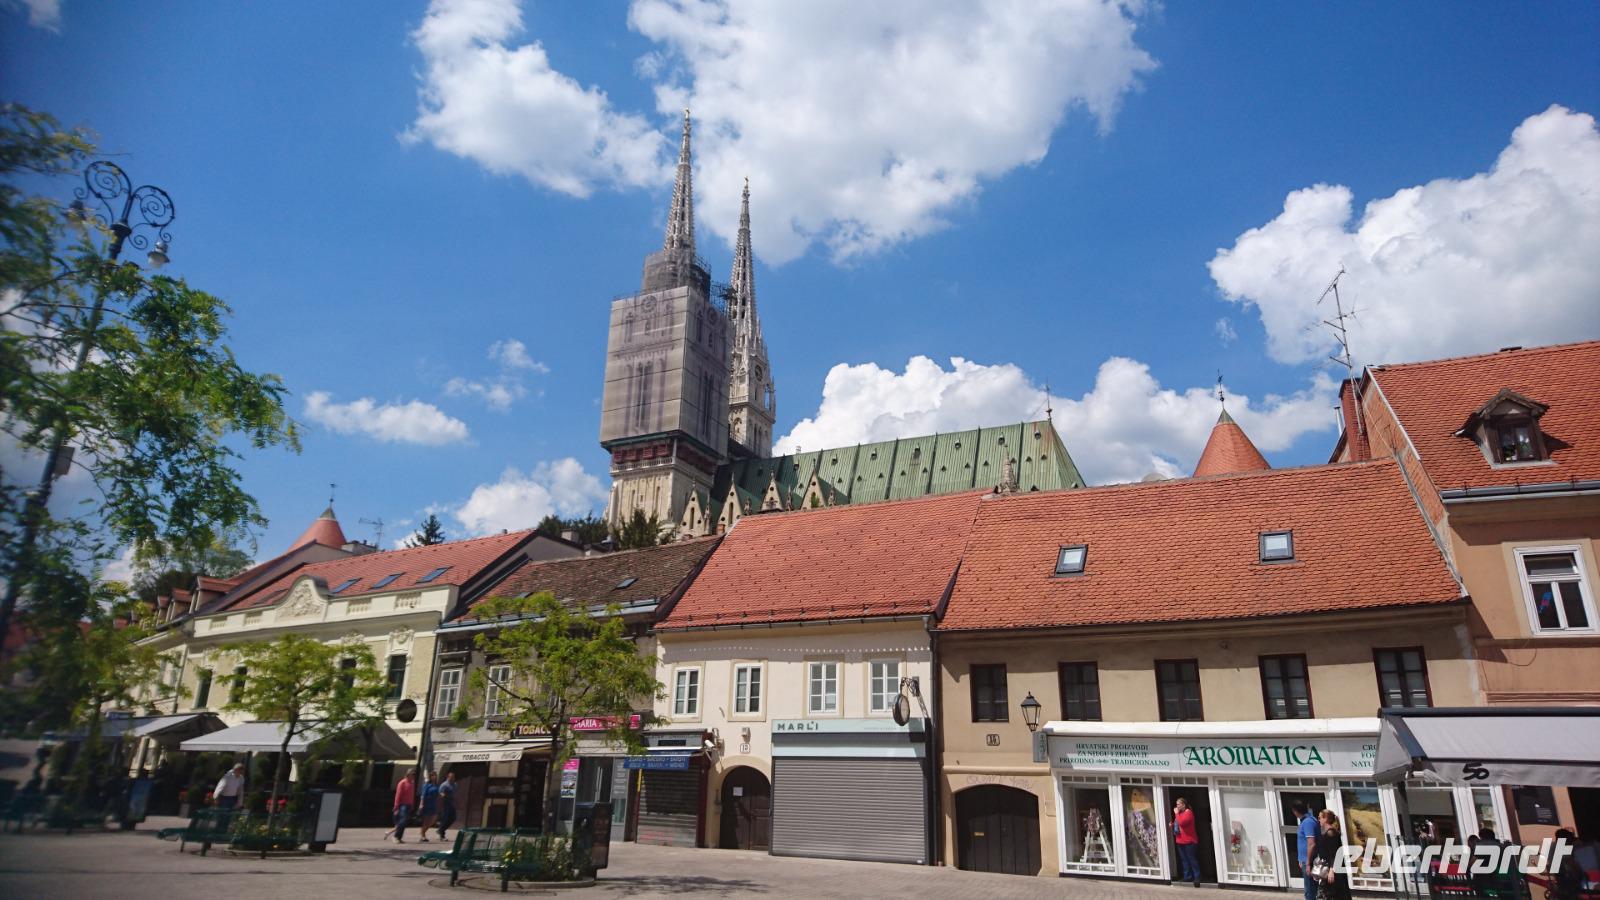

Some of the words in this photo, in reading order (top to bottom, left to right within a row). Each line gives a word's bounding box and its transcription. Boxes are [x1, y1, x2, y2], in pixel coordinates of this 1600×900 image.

[518, 725, 552, 735] TOBACC
[1182, 745, 1326, 766] AROMATICA
[1110, 758, 1170, 766] TRADICIONALNO
